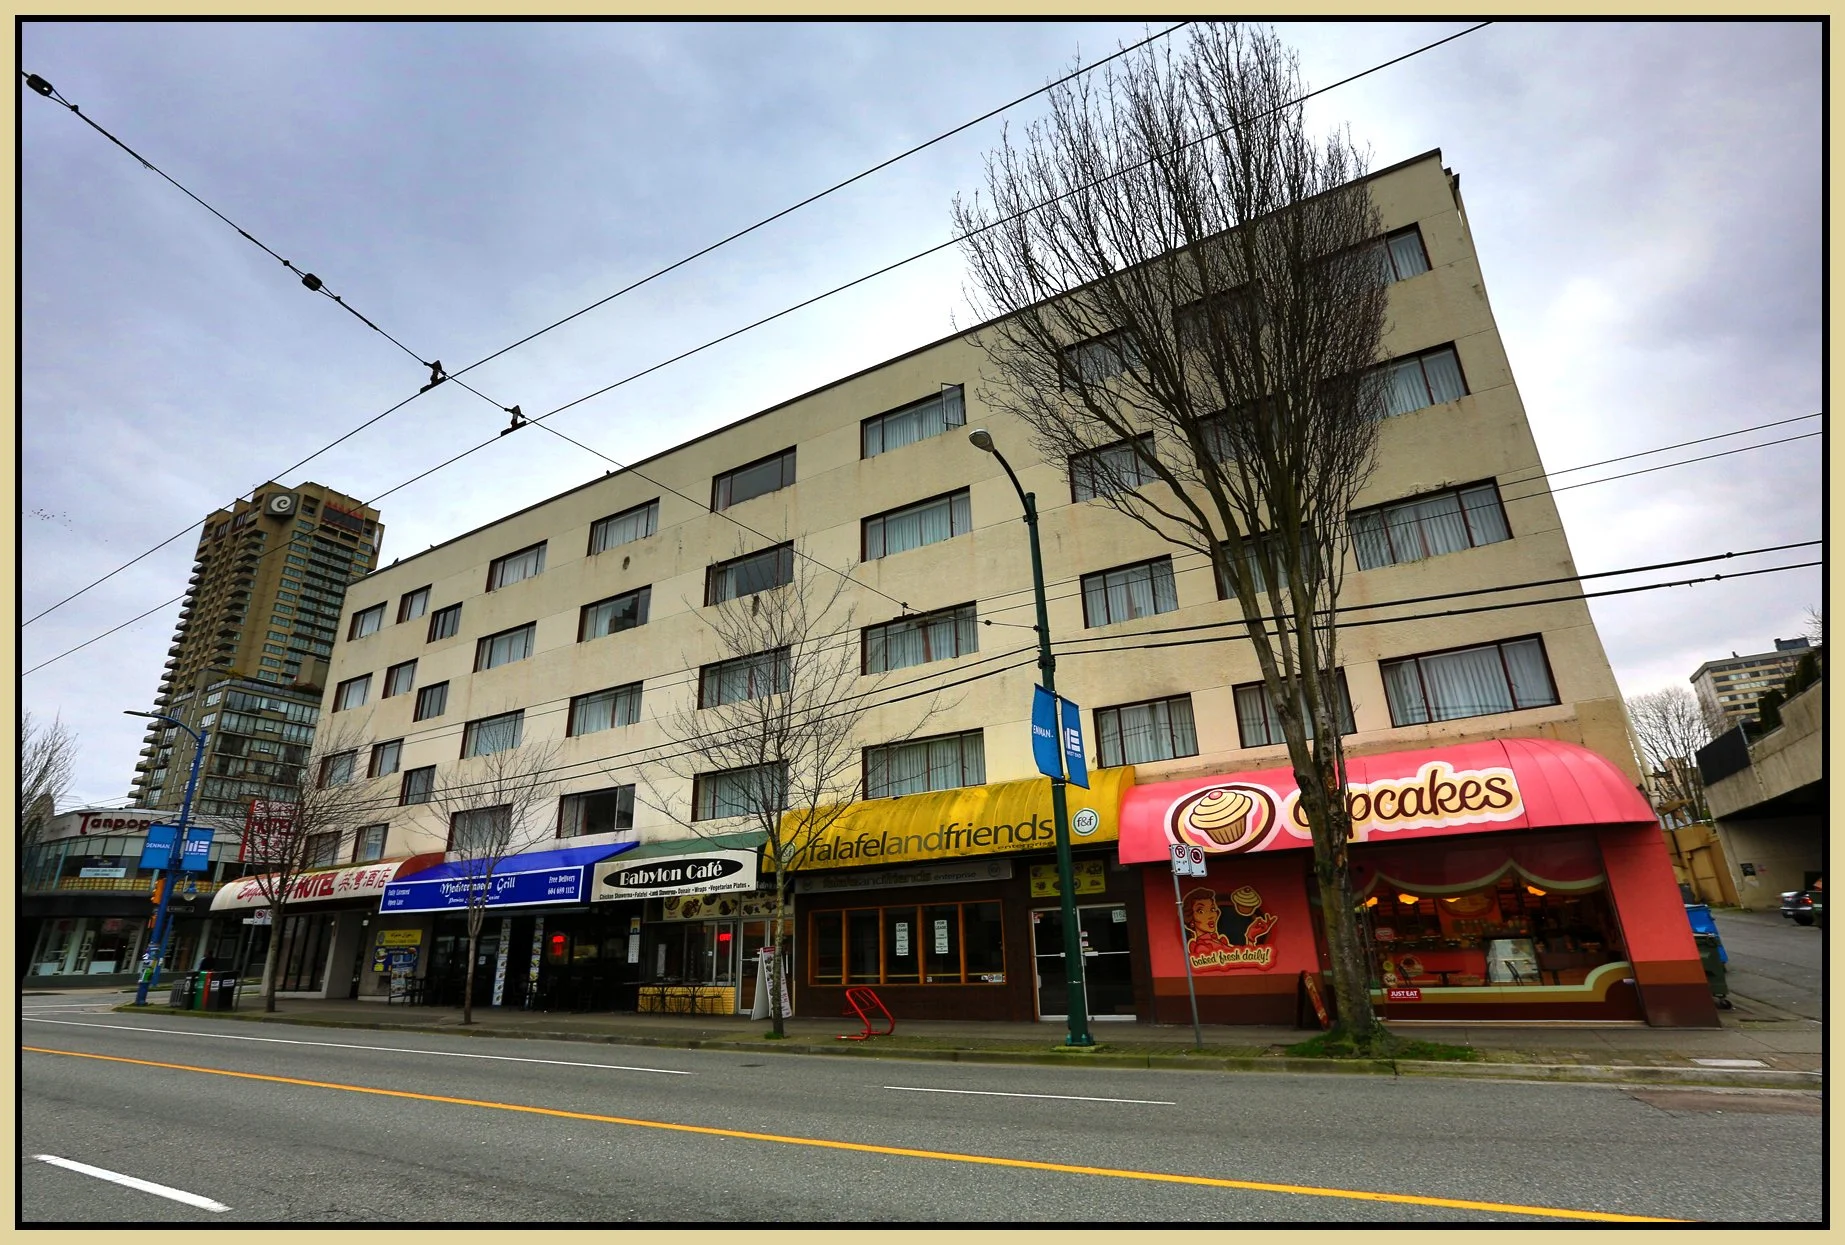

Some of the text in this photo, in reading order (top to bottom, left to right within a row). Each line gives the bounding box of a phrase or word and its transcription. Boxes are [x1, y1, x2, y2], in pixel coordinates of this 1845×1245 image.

[1032, 724, 1051, 738] ENMAN
[1293, 769, 1513, 839] cpcakes
[77, 812, 163, 835] Tanpop
[1077, 816, 1093, 827] f&f
[619, 861, 723, 886] Babylon Café
[934, 870, 977, 881] enterprise
[293, 872, 339, 899] HOTEL
[496, 876, 516, 893] Grill
[1191, 948, 1270, 967] baked fresh daily!
